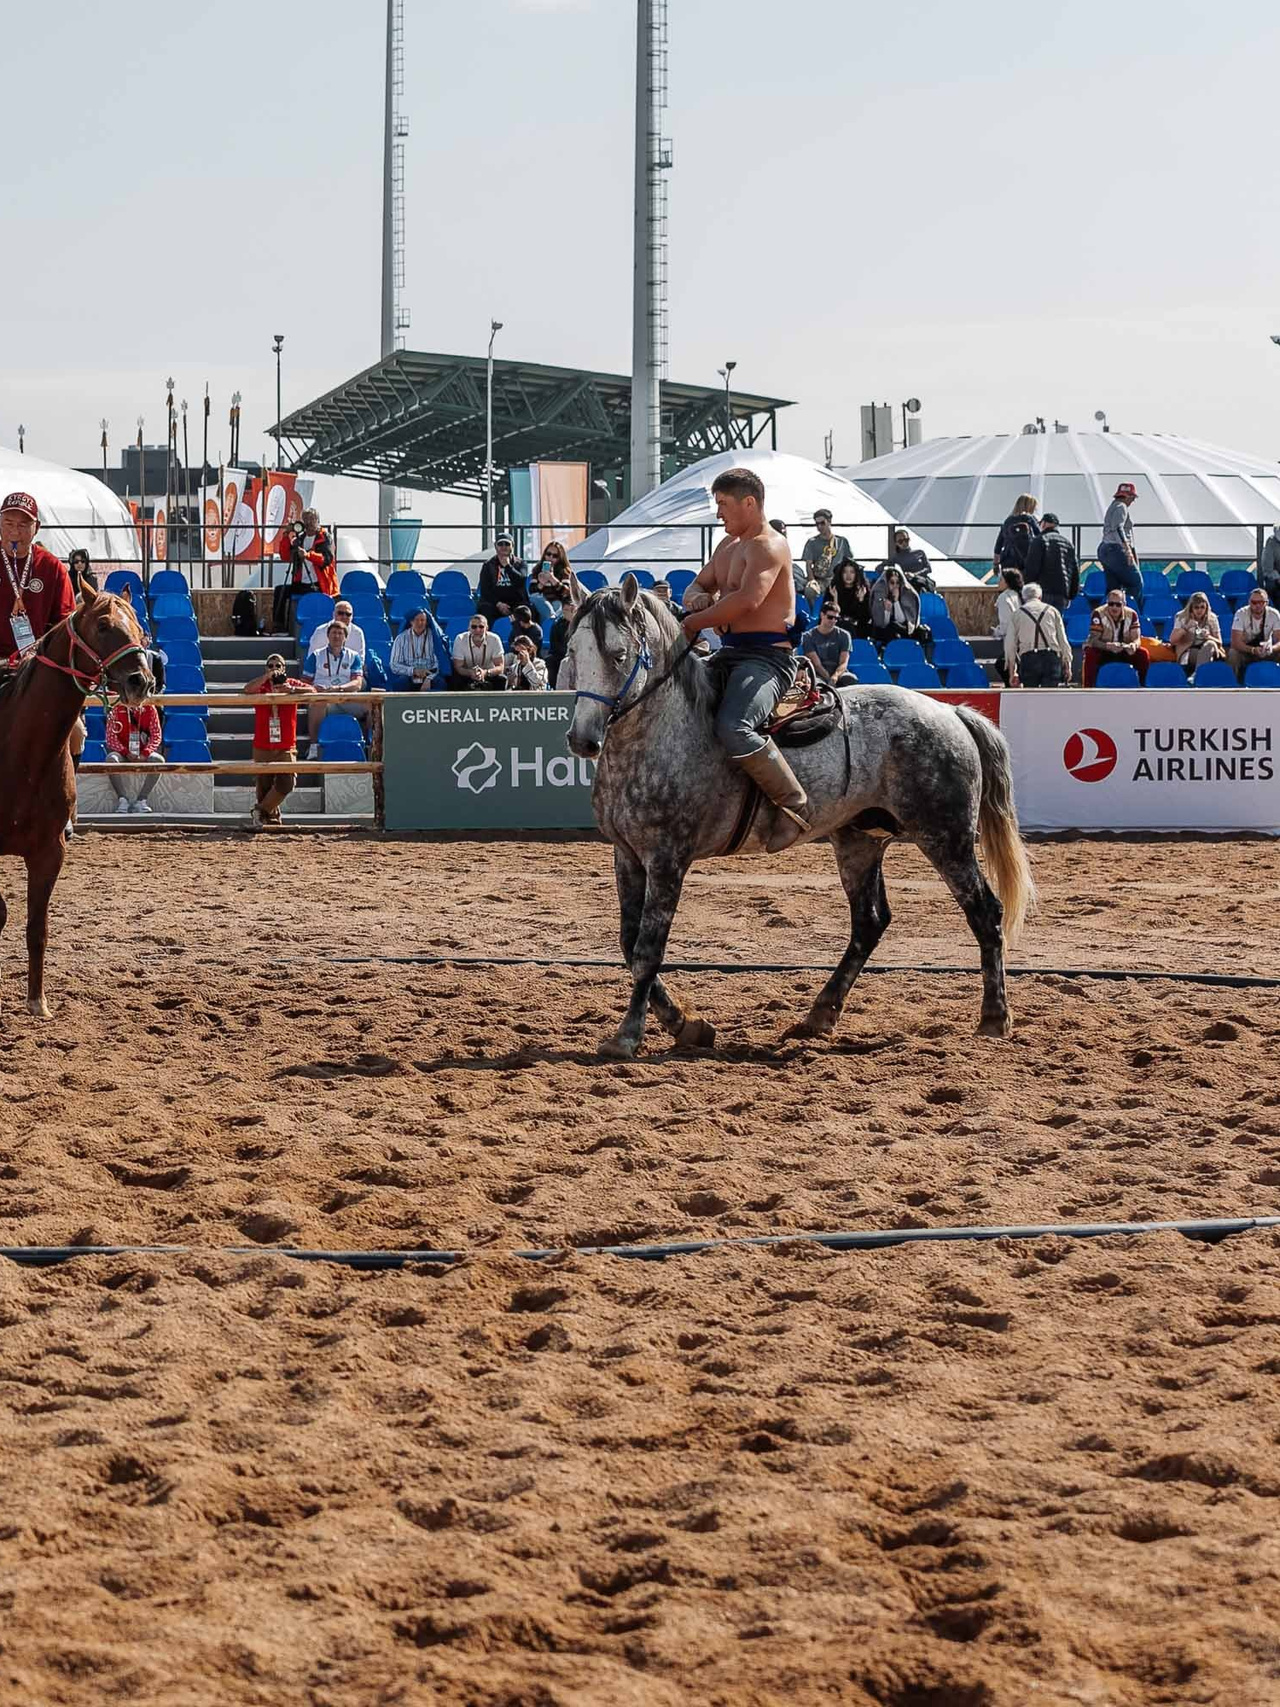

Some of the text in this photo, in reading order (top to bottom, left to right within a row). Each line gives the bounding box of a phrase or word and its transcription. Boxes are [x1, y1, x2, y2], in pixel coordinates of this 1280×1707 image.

[401, 706, 570, 724] GENERAL PARTNER
[1133, 728, 1272, 752] TURKISH
[510, 747, 598, 787] Hal
[1131, 757, 1274, 781] AIRLINES
